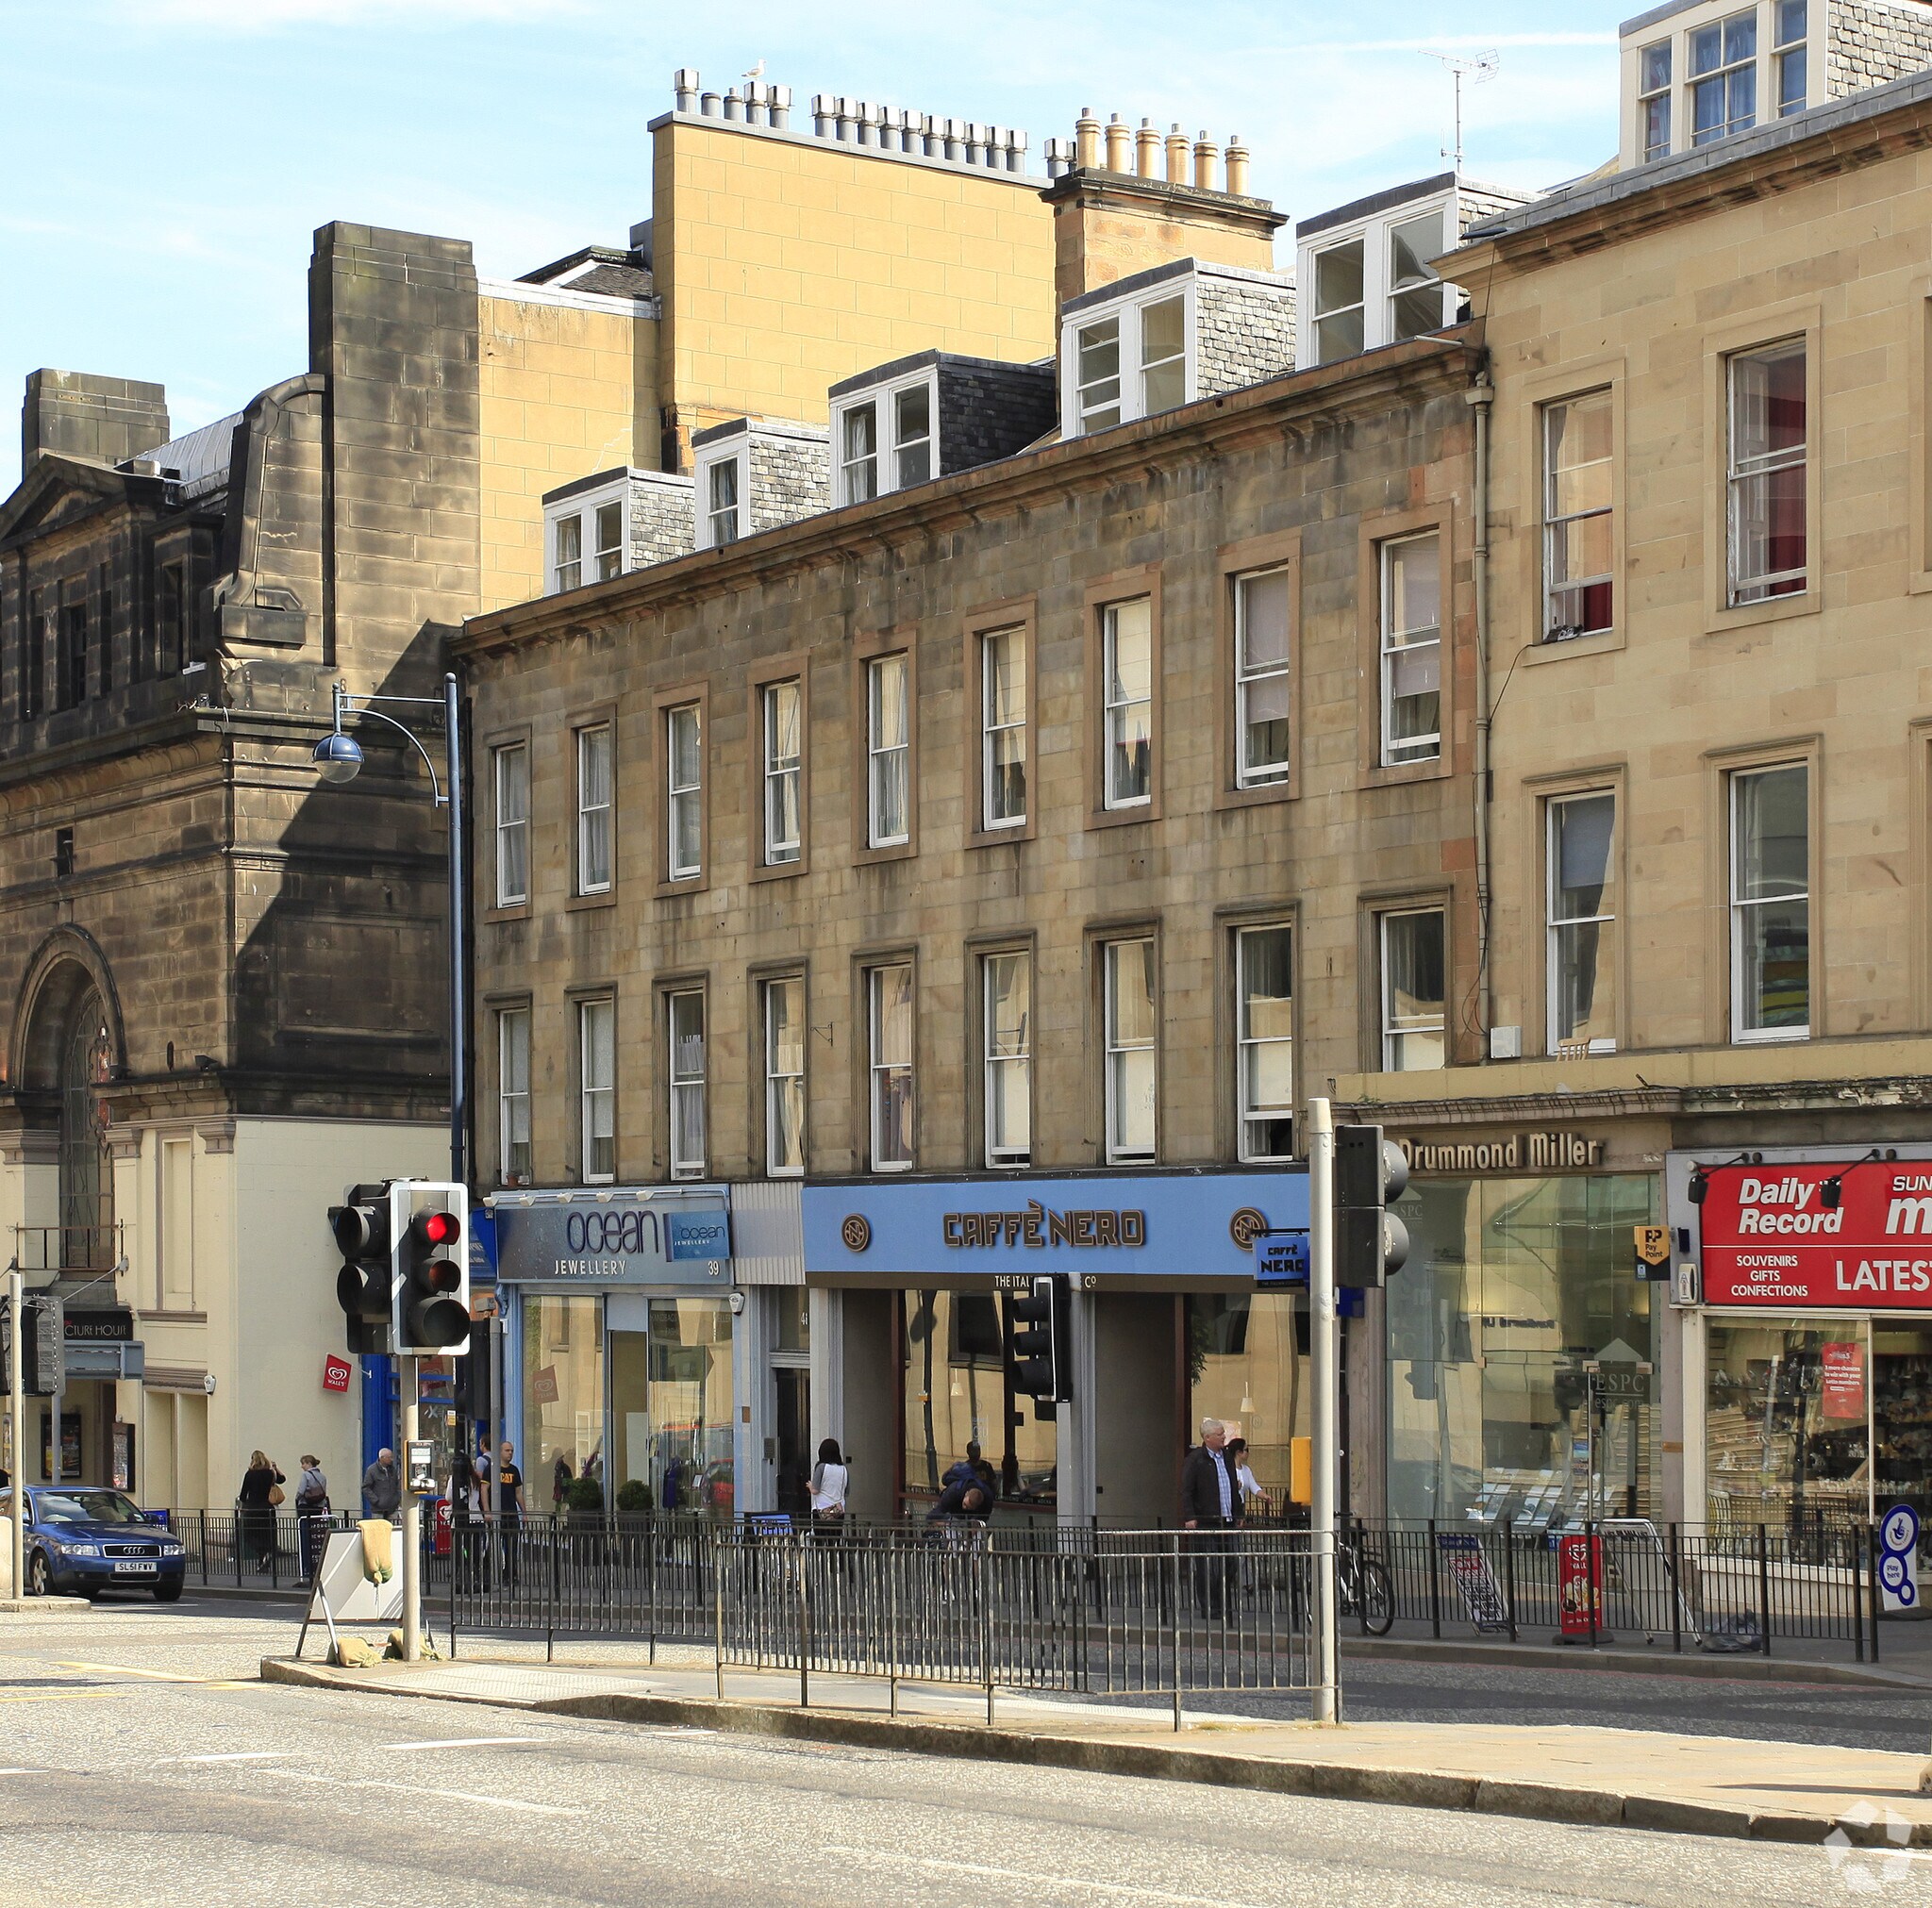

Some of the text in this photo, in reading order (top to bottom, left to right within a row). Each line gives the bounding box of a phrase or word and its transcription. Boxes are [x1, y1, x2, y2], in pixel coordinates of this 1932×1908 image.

[1398, 1133, 1597, 1170] Drummond Miller
[1739, 1178, 1815, 1210] Daily
[1394, 1204, 1423, 1217] SPC
[943, 1199, 1144, 1247] CAFFÈ NERO
[1739, 1207, 1844, 1234] Record
[567, 1211, 658, 1253] ocean
[680, 1226, 724, 1239] ocean
[555, 1260, 719, 1274] JEWELLERY 39
[1737, 1255, 1798, 1267] SOUVENIRS
[994, 1276, 1010, 1287] THE
[1012, 1276, 1030, 1287] ITAL
[1750, 1270, 1780, 1282] GIFTS
[1836, 1260, 1932, 1291] LATES
[1731, 1285, 1808, 1297] CONFECTIONS
[64, 1325, 92, 1336] CTURE
[1595, 1373, 1644, 1392] ESPC
